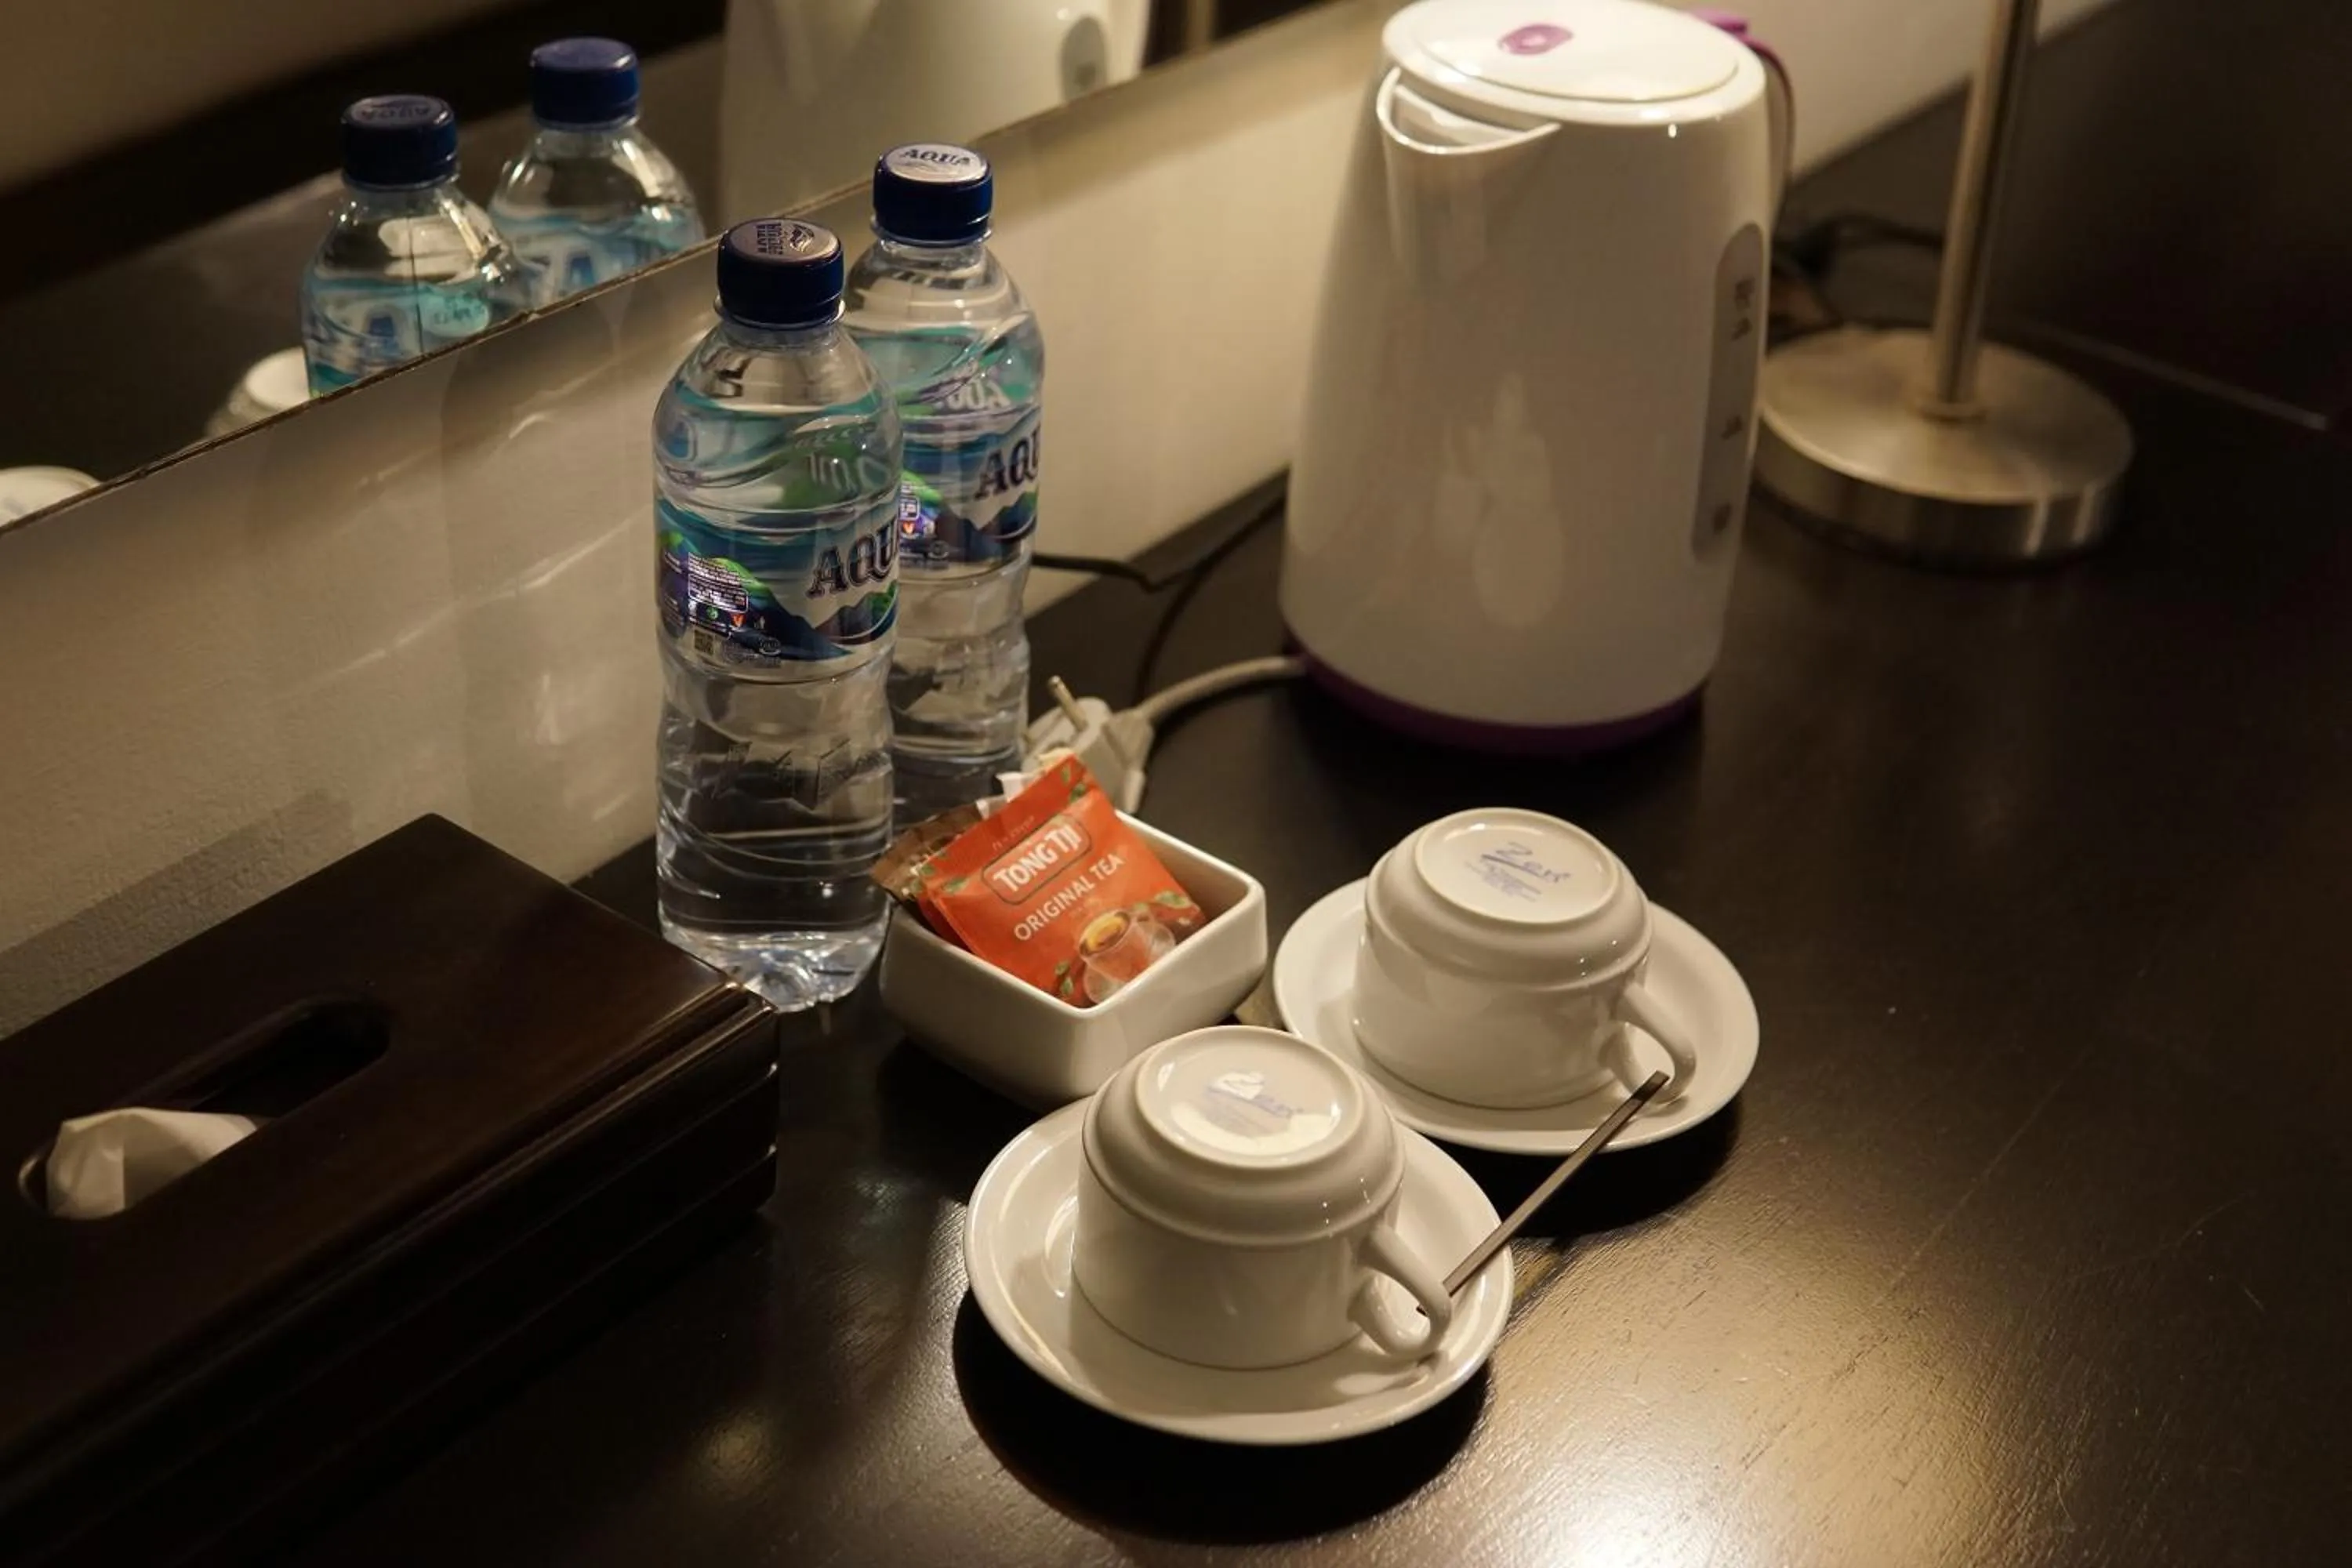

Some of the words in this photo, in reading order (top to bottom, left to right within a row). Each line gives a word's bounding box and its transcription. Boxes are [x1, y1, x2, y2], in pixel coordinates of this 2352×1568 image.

[901, 149, 971, 165] AQUA
[974, 420, 1041, 500] AQU
[805, 515, 898, 598] AQU
[993, 842, 1058, 892] TONG
[1044, 824, 1082, 853] TJI
[1014, 875, 1095, 941] ORIGINAL
[1088, 853, 1125, 880] TEA
